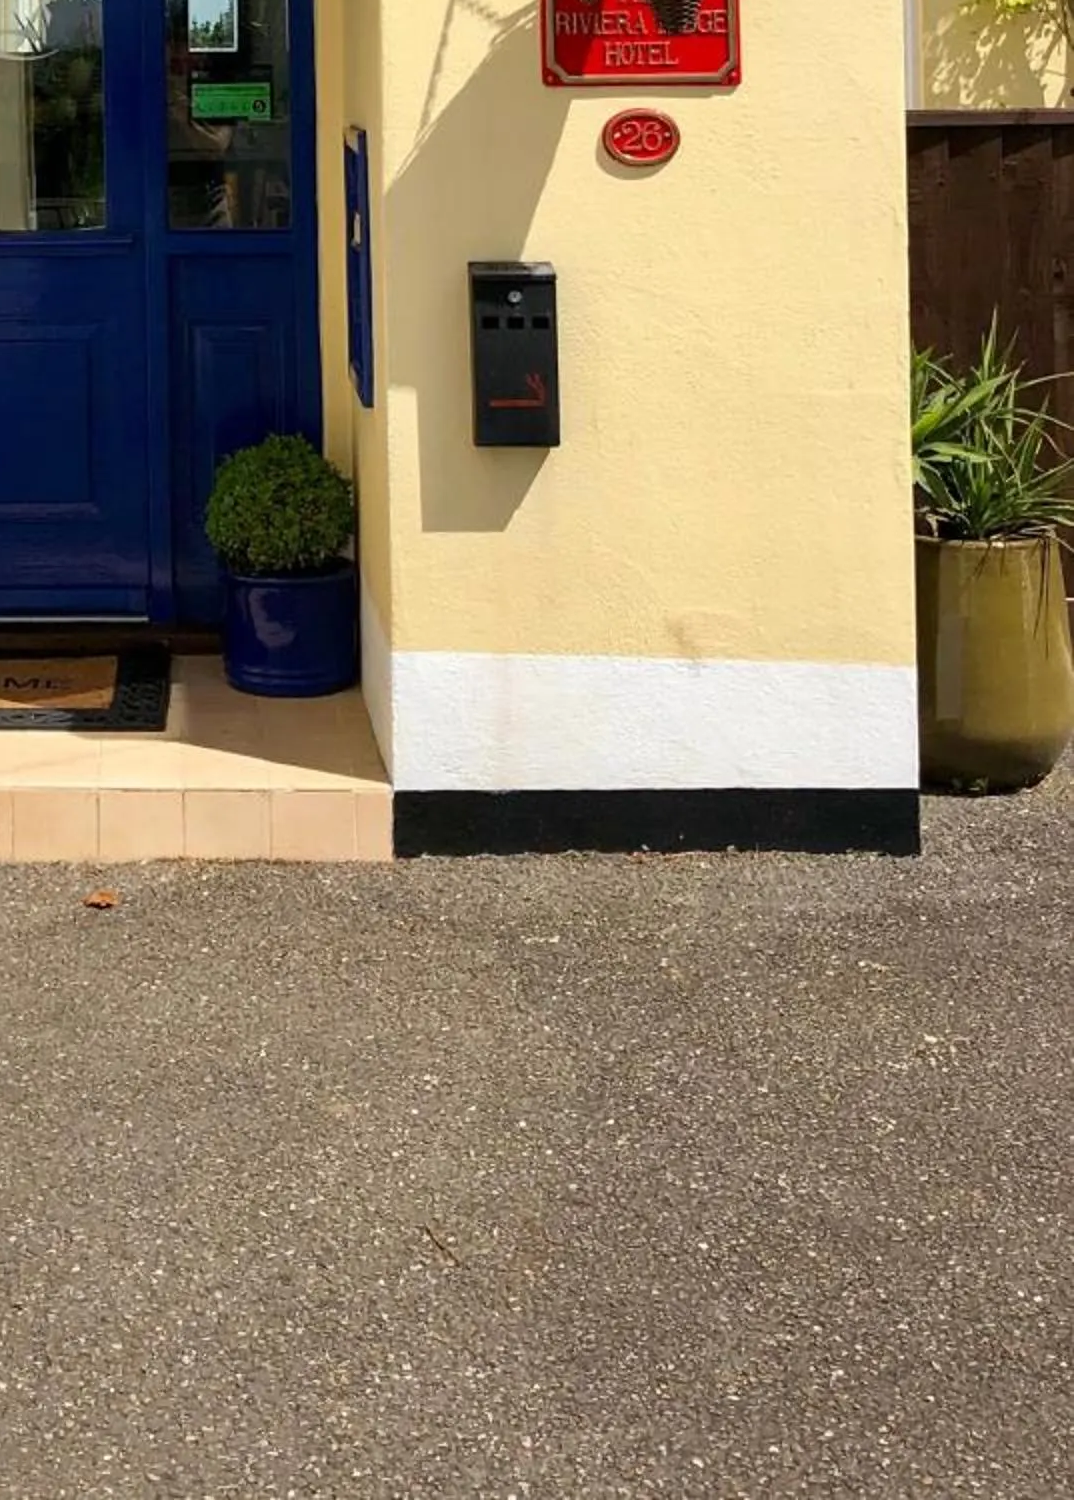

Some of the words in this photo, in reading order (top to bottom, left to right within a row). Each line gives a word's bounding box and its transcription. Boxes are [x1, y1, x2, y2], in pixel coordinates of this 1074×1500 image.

[555, 9, 648, 37] RIVIERA
[603, 40, 680, 67] HOTEL
[621, 121, 663, 152] 26
